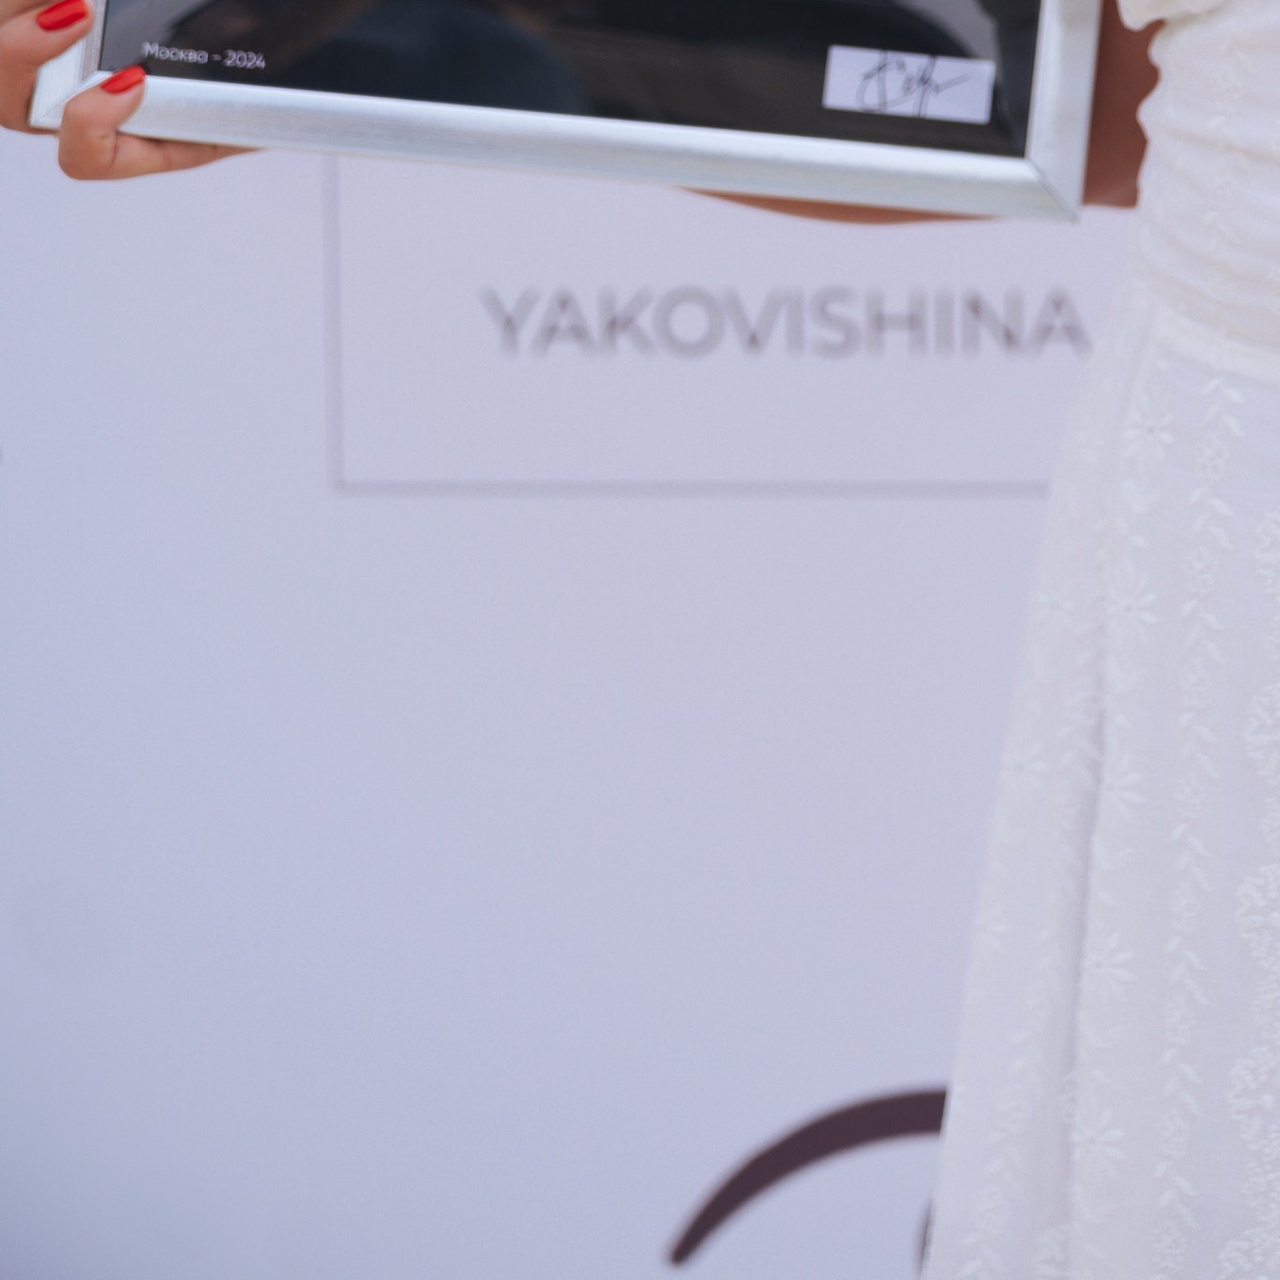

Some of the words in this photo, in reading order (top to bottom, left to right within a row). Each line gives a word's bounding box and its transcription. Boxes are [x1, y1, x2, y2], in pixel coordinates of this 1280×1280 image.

[143, 42, 209, 65] Москва
[223, 49, 267, 70] 2024
[480, 286, 1094, 360] YAKOVISHINA
